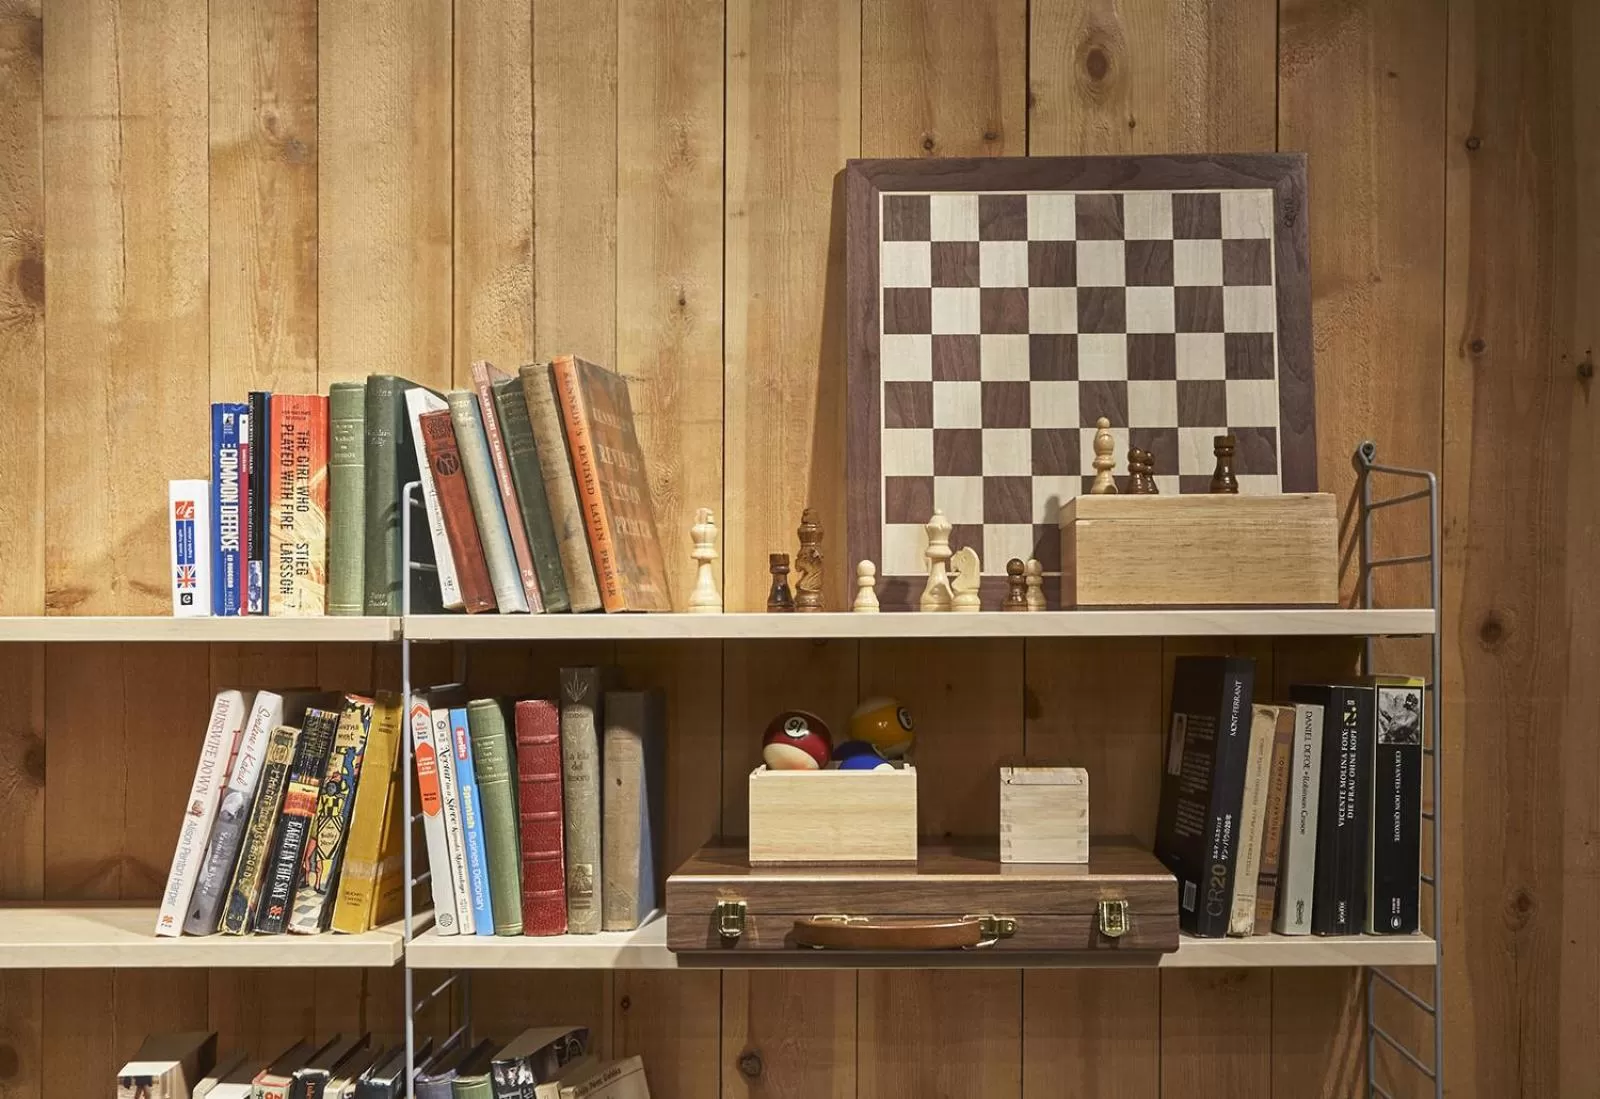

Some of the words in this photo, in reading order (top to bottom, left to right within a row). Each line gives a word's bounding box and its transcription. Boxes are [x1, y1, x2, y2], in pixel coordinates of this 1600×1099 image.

[280, 424, 294, 467] PLAYED
[295, 430, 310, 453] THE
[220, 449, 239, 504] COMMON
[295, 456, 310, 482] GIRL
[280, 471, 294, 500] WITH
[295, 485, 310, 512] WHO
[220, 505, 239, 552] DEFENSE
[280, 503, 294, 530] FIRE
[579, 445, 595, 496] REVISED
[590, 503, 606, 541] LATIN
[600, 550, 617, 598] PRIMER
[280, 543, 294, 594] LARSSON
[295, 543, 310, 575] STIEG
[207, 698, 230, 759] HOUSEWIFE
[1304, 711, 1313, 741] DANIEL
[1349, 729, 1357, 750] KOPF
[1303, 744, 1312, 770] DEFOE
[1339, 752, 1347, 788] MOLINA
[1348, 752, 1356, 777] OHNE
[195, 760, 216, 796] DOWN
[1347, 779, 1355, 801] FRAU
[461, 784, 476, 829] Spanish
[1337, 789, 1346, 827] VICENTE
[1346, 803, 1354, 818] DIE
[286, 820, 303, 850] EAGLE
[467, 830, 481, 867] Business
[279, 848, 296, 862] IN
[275, 860, 293, 883] THE
[271, 881, 290, 900] SKY
[471, 868, 485, 911] Dictionary
[1205, 864, 1228, 917] CR20
